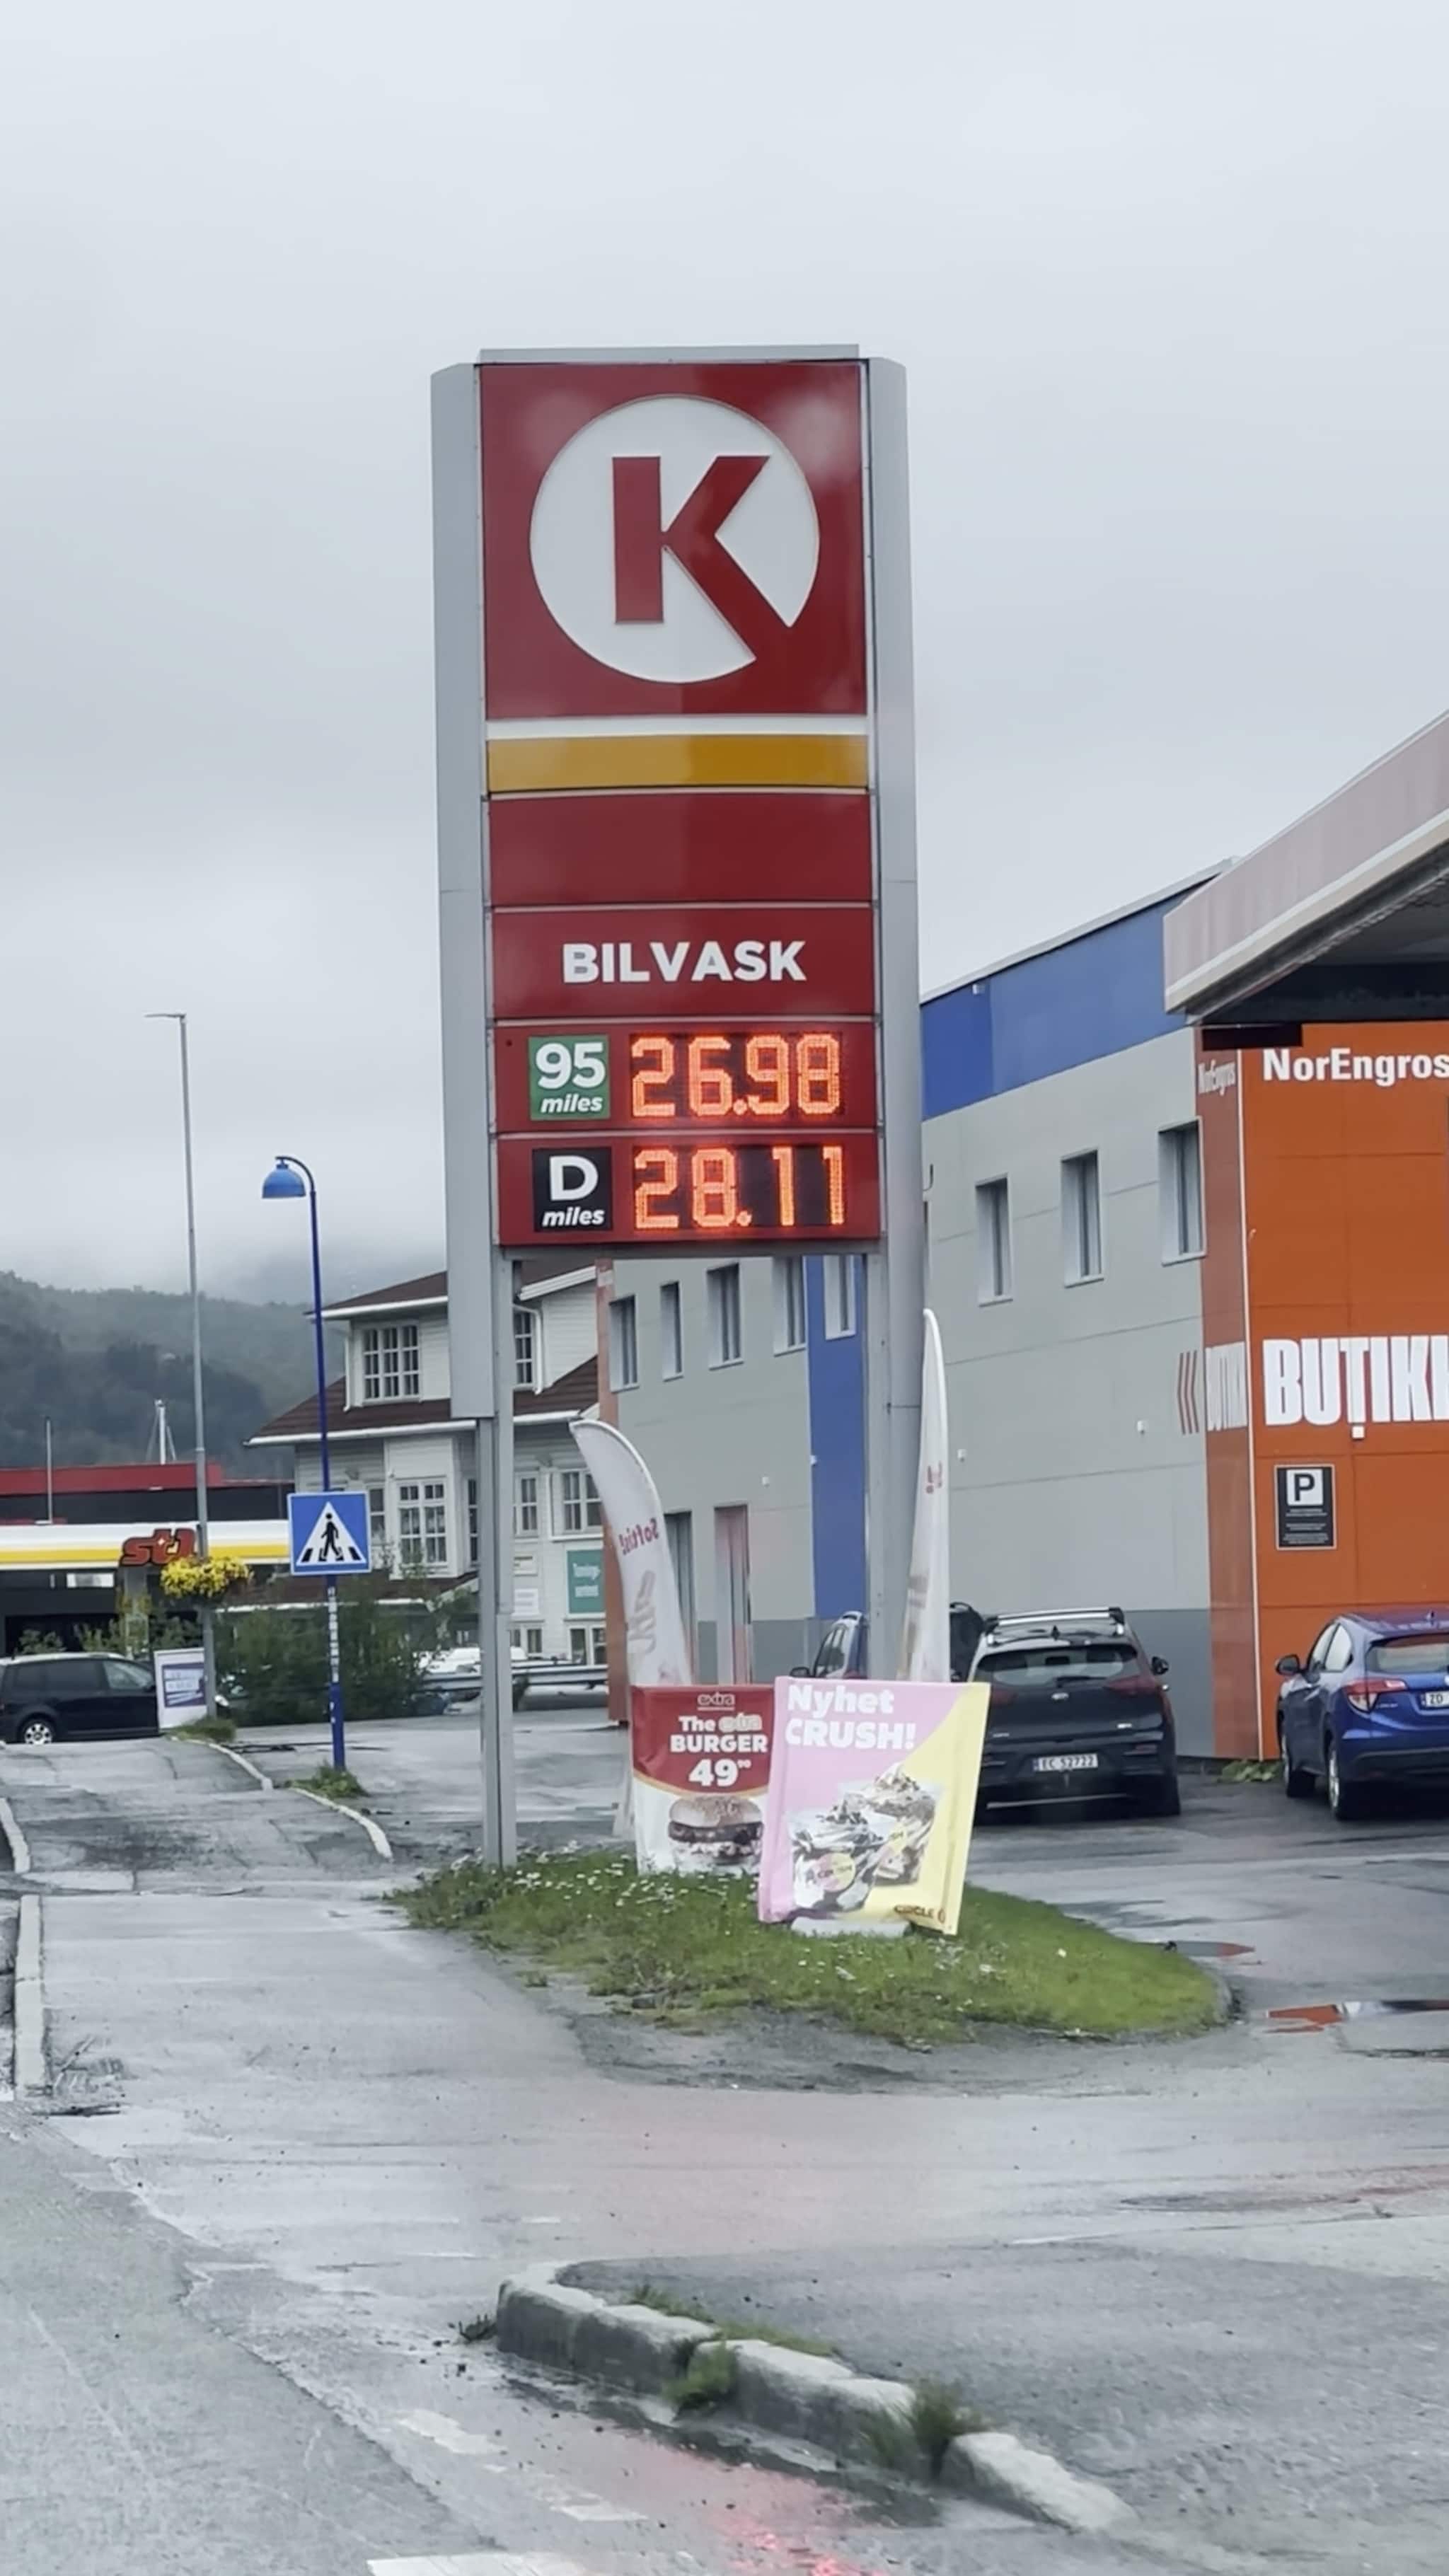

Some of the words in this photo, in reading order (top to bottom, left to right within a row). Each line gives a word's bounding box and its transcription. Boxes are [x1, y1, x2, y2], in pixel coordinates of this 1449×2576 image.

[612, 455, 788, 659] K
[562, 940, 807, 983] BILVASK
[535, 1042, 606, 1090] 95
[631, 1034, 841, 1117] 26.98
[1262, 1047, 1449, 1087] NorEngros
[540, 1093, 603, 1114] miles
[549, 1155, 599, 1201] D
[635, 1145, 845, 1229] 28.11
[541, 1206, 605, 1227] miles
[1294, 1473, 1315, 1501] P
[697, 1692, 736, 1706] extra
[787, 1684, 895, 1719] Nyhet
[678, 1714, 716, 1732] The
[785, 1717, 917, 1750] CRUSH!
[669, 1734, 768, 1753] BURGER
